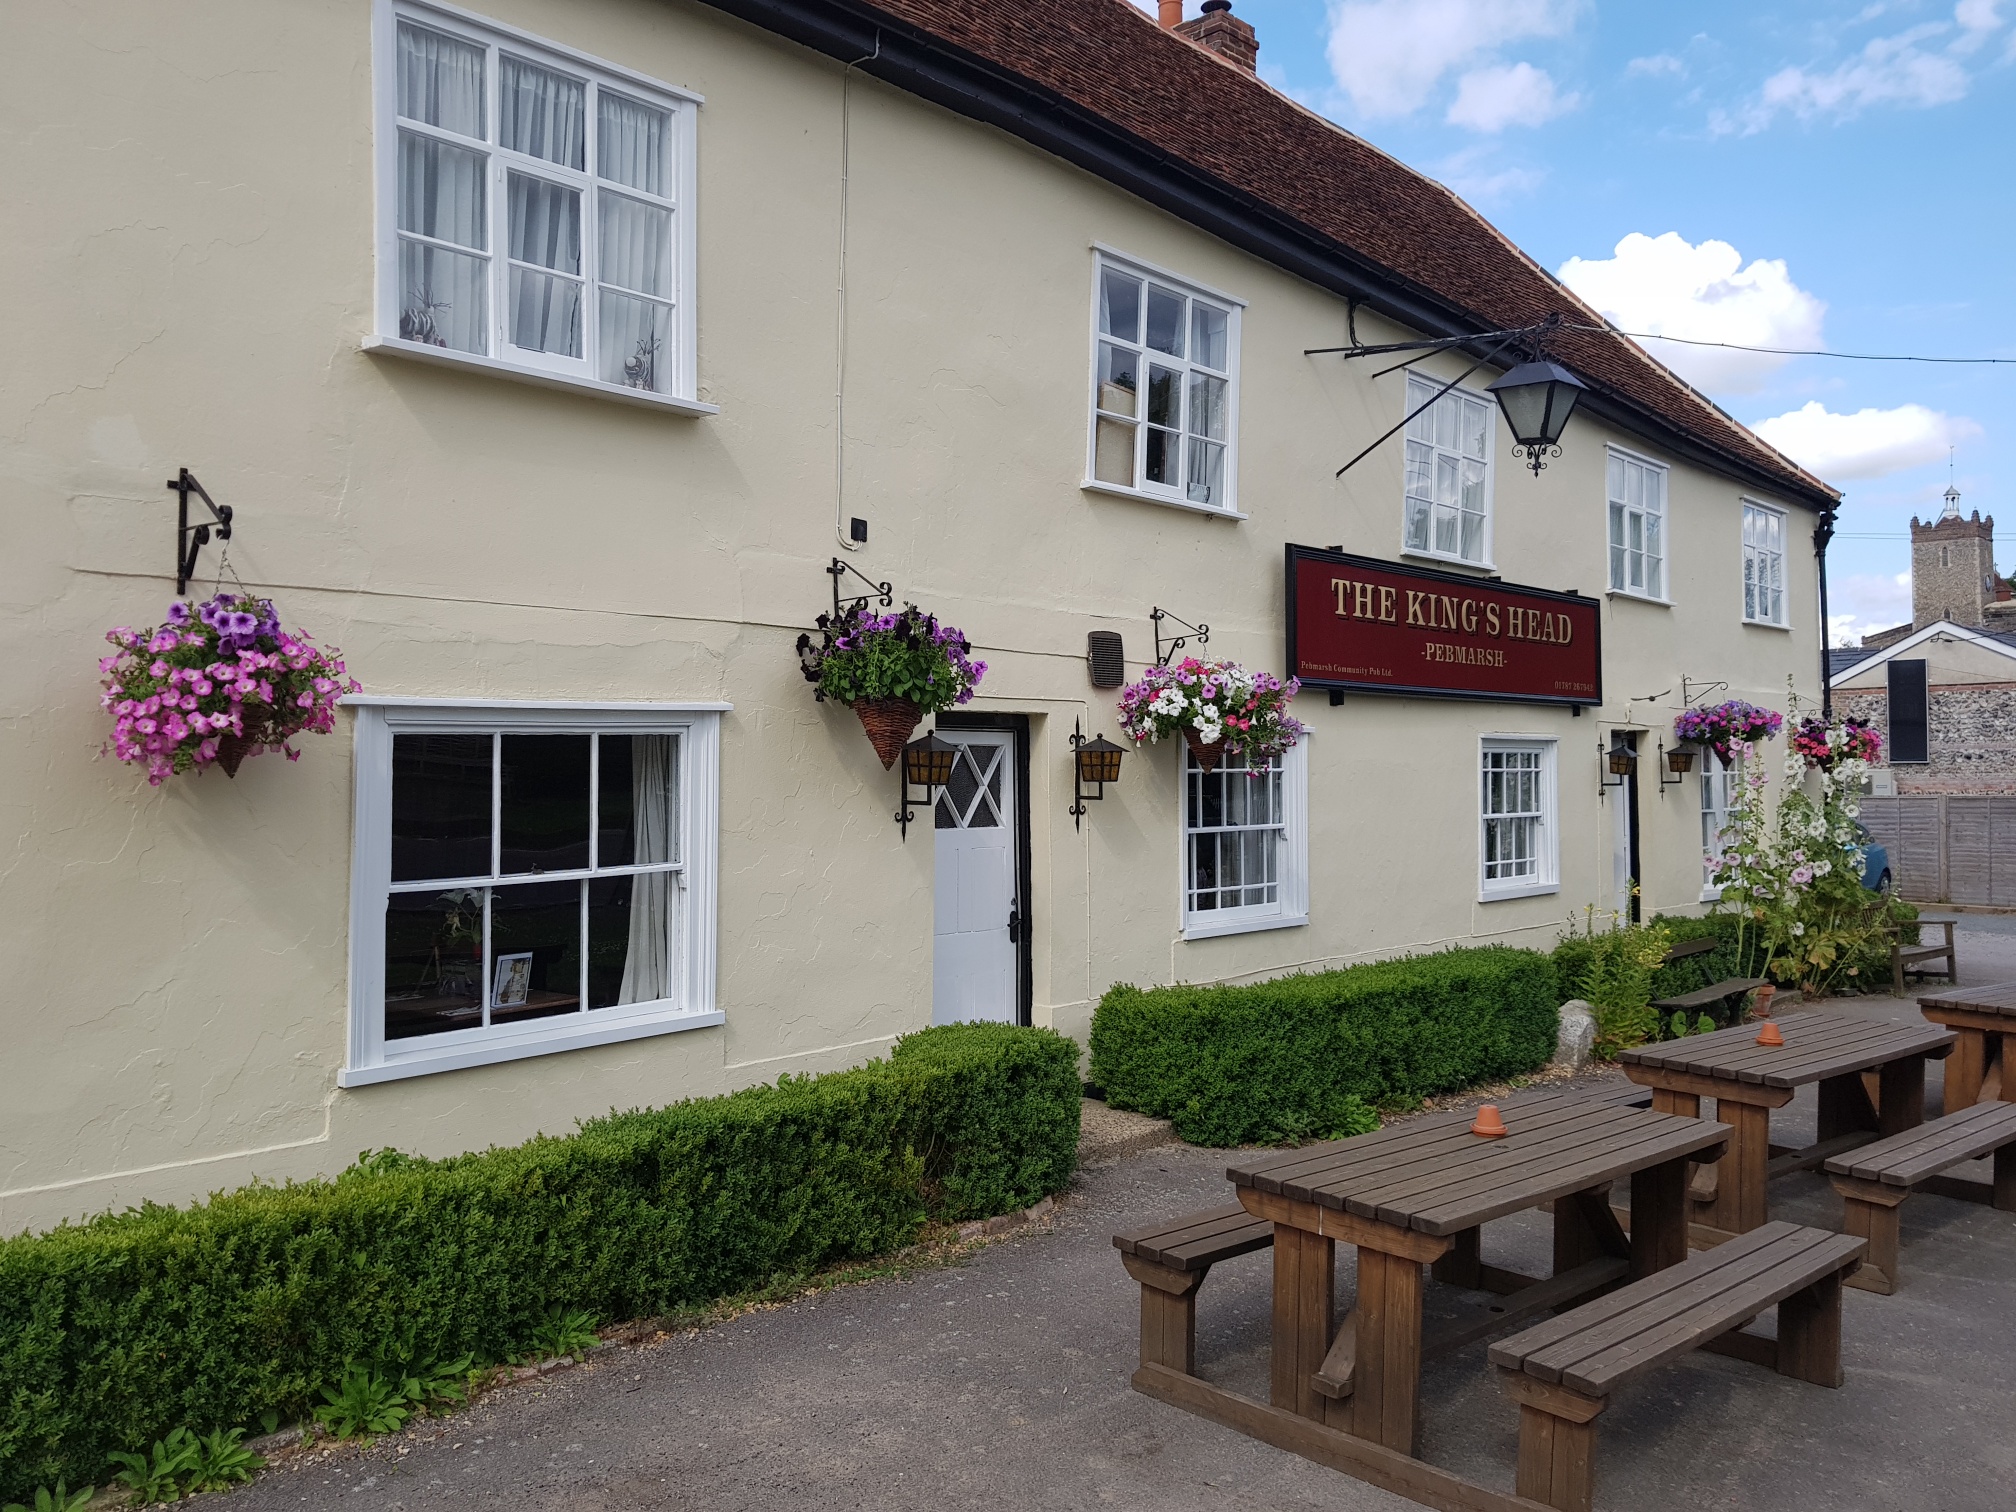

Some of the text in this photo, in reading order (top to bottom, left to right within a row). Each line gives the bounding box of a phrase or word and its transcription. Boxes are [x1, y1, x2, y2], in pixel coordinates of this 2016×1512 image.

[1331, 577, 1573, 645] THE KING'S HEAD
[1301, 660, 1393, 677] Pebmarsh Community Pub Ltd.
[1554, 680, 1572, 690] 01787
